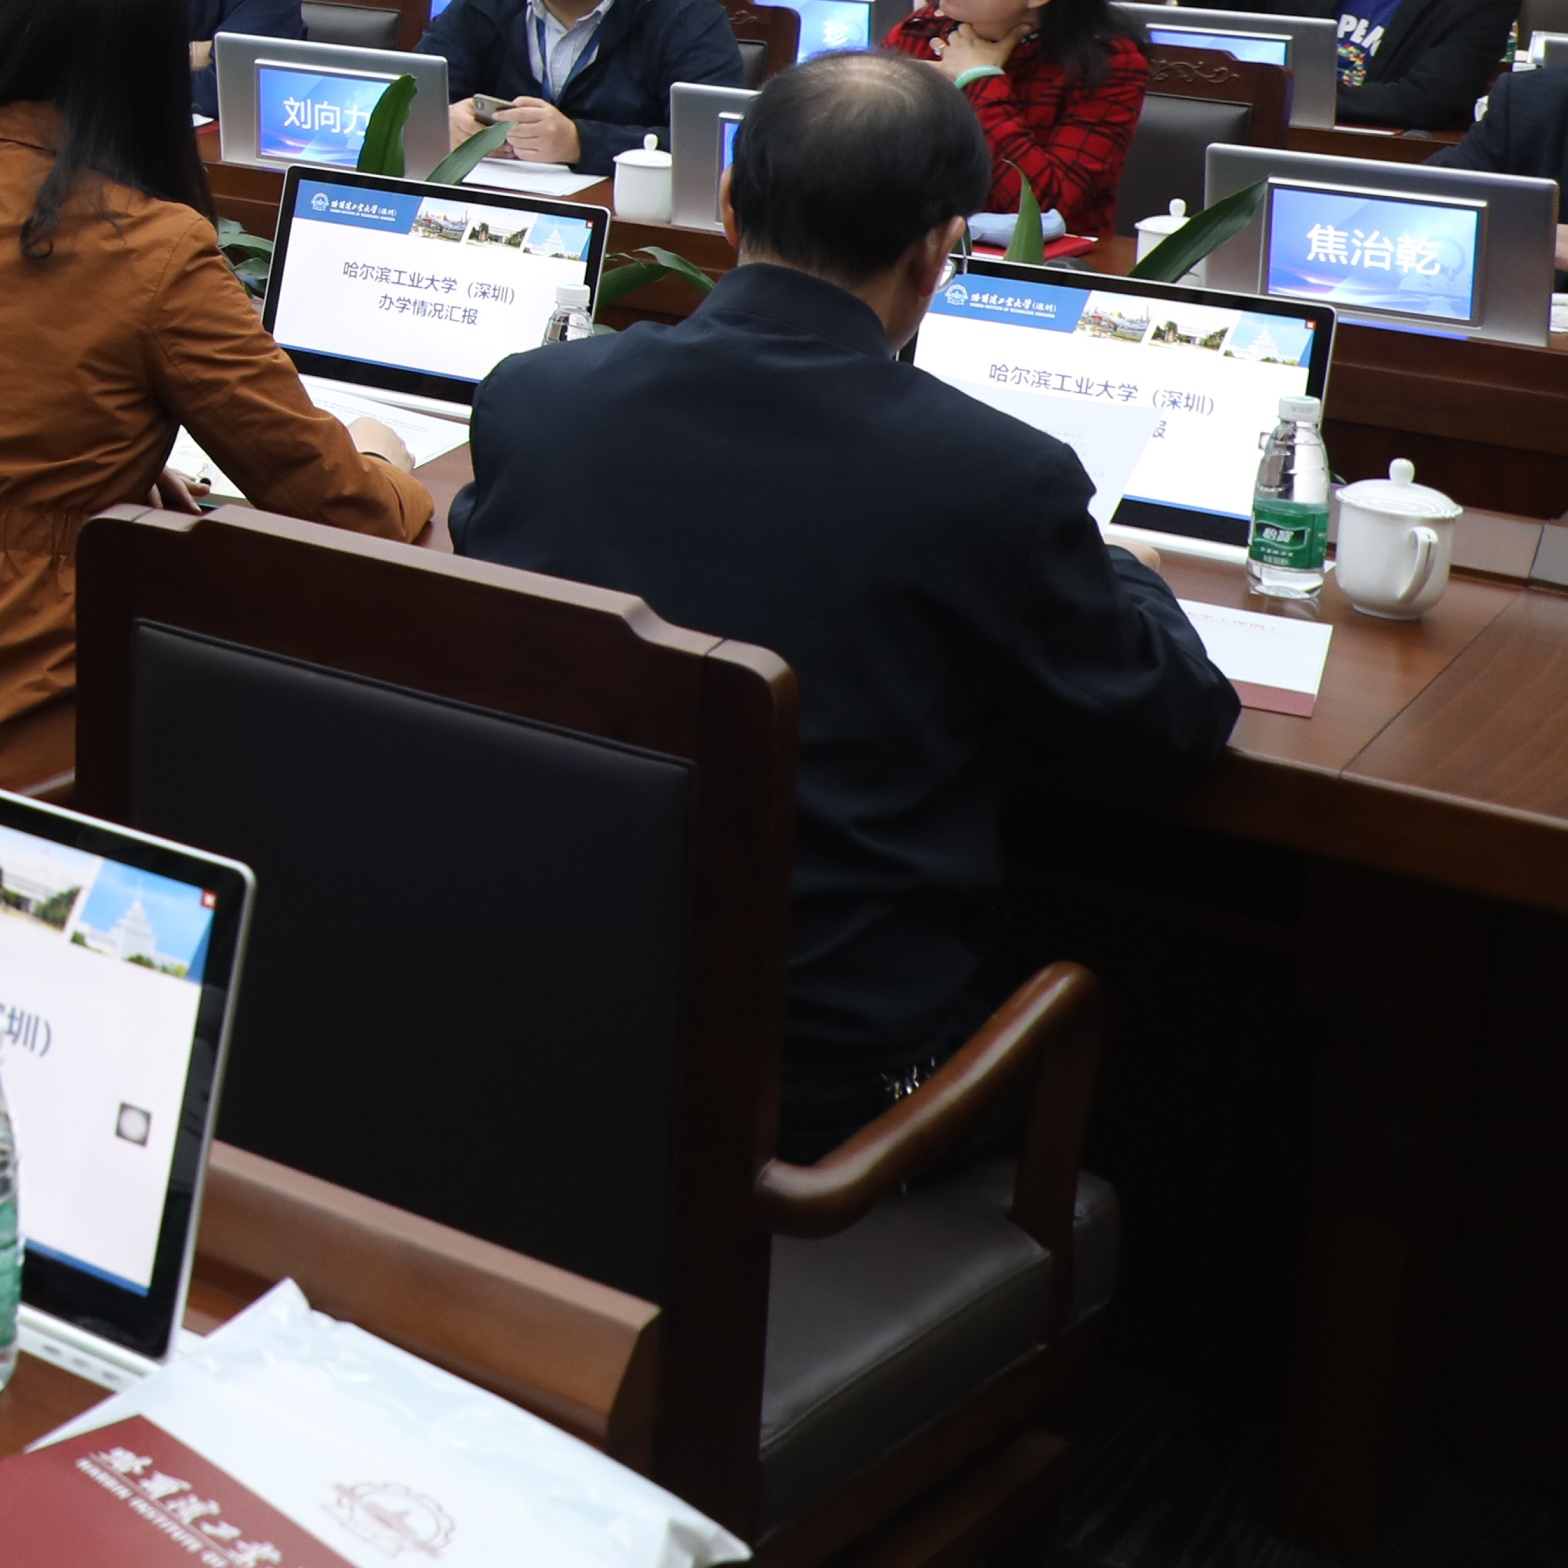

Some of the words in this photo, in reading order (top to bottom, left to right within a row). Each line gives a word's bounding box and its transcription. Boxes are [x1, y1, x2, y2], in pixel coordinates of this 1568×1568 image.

[282, 96, 371, 137] 刘向力
[1306, 223, 1442, 276] 焦治乾
[378, 292, 479, 326] 办学情况汇报
